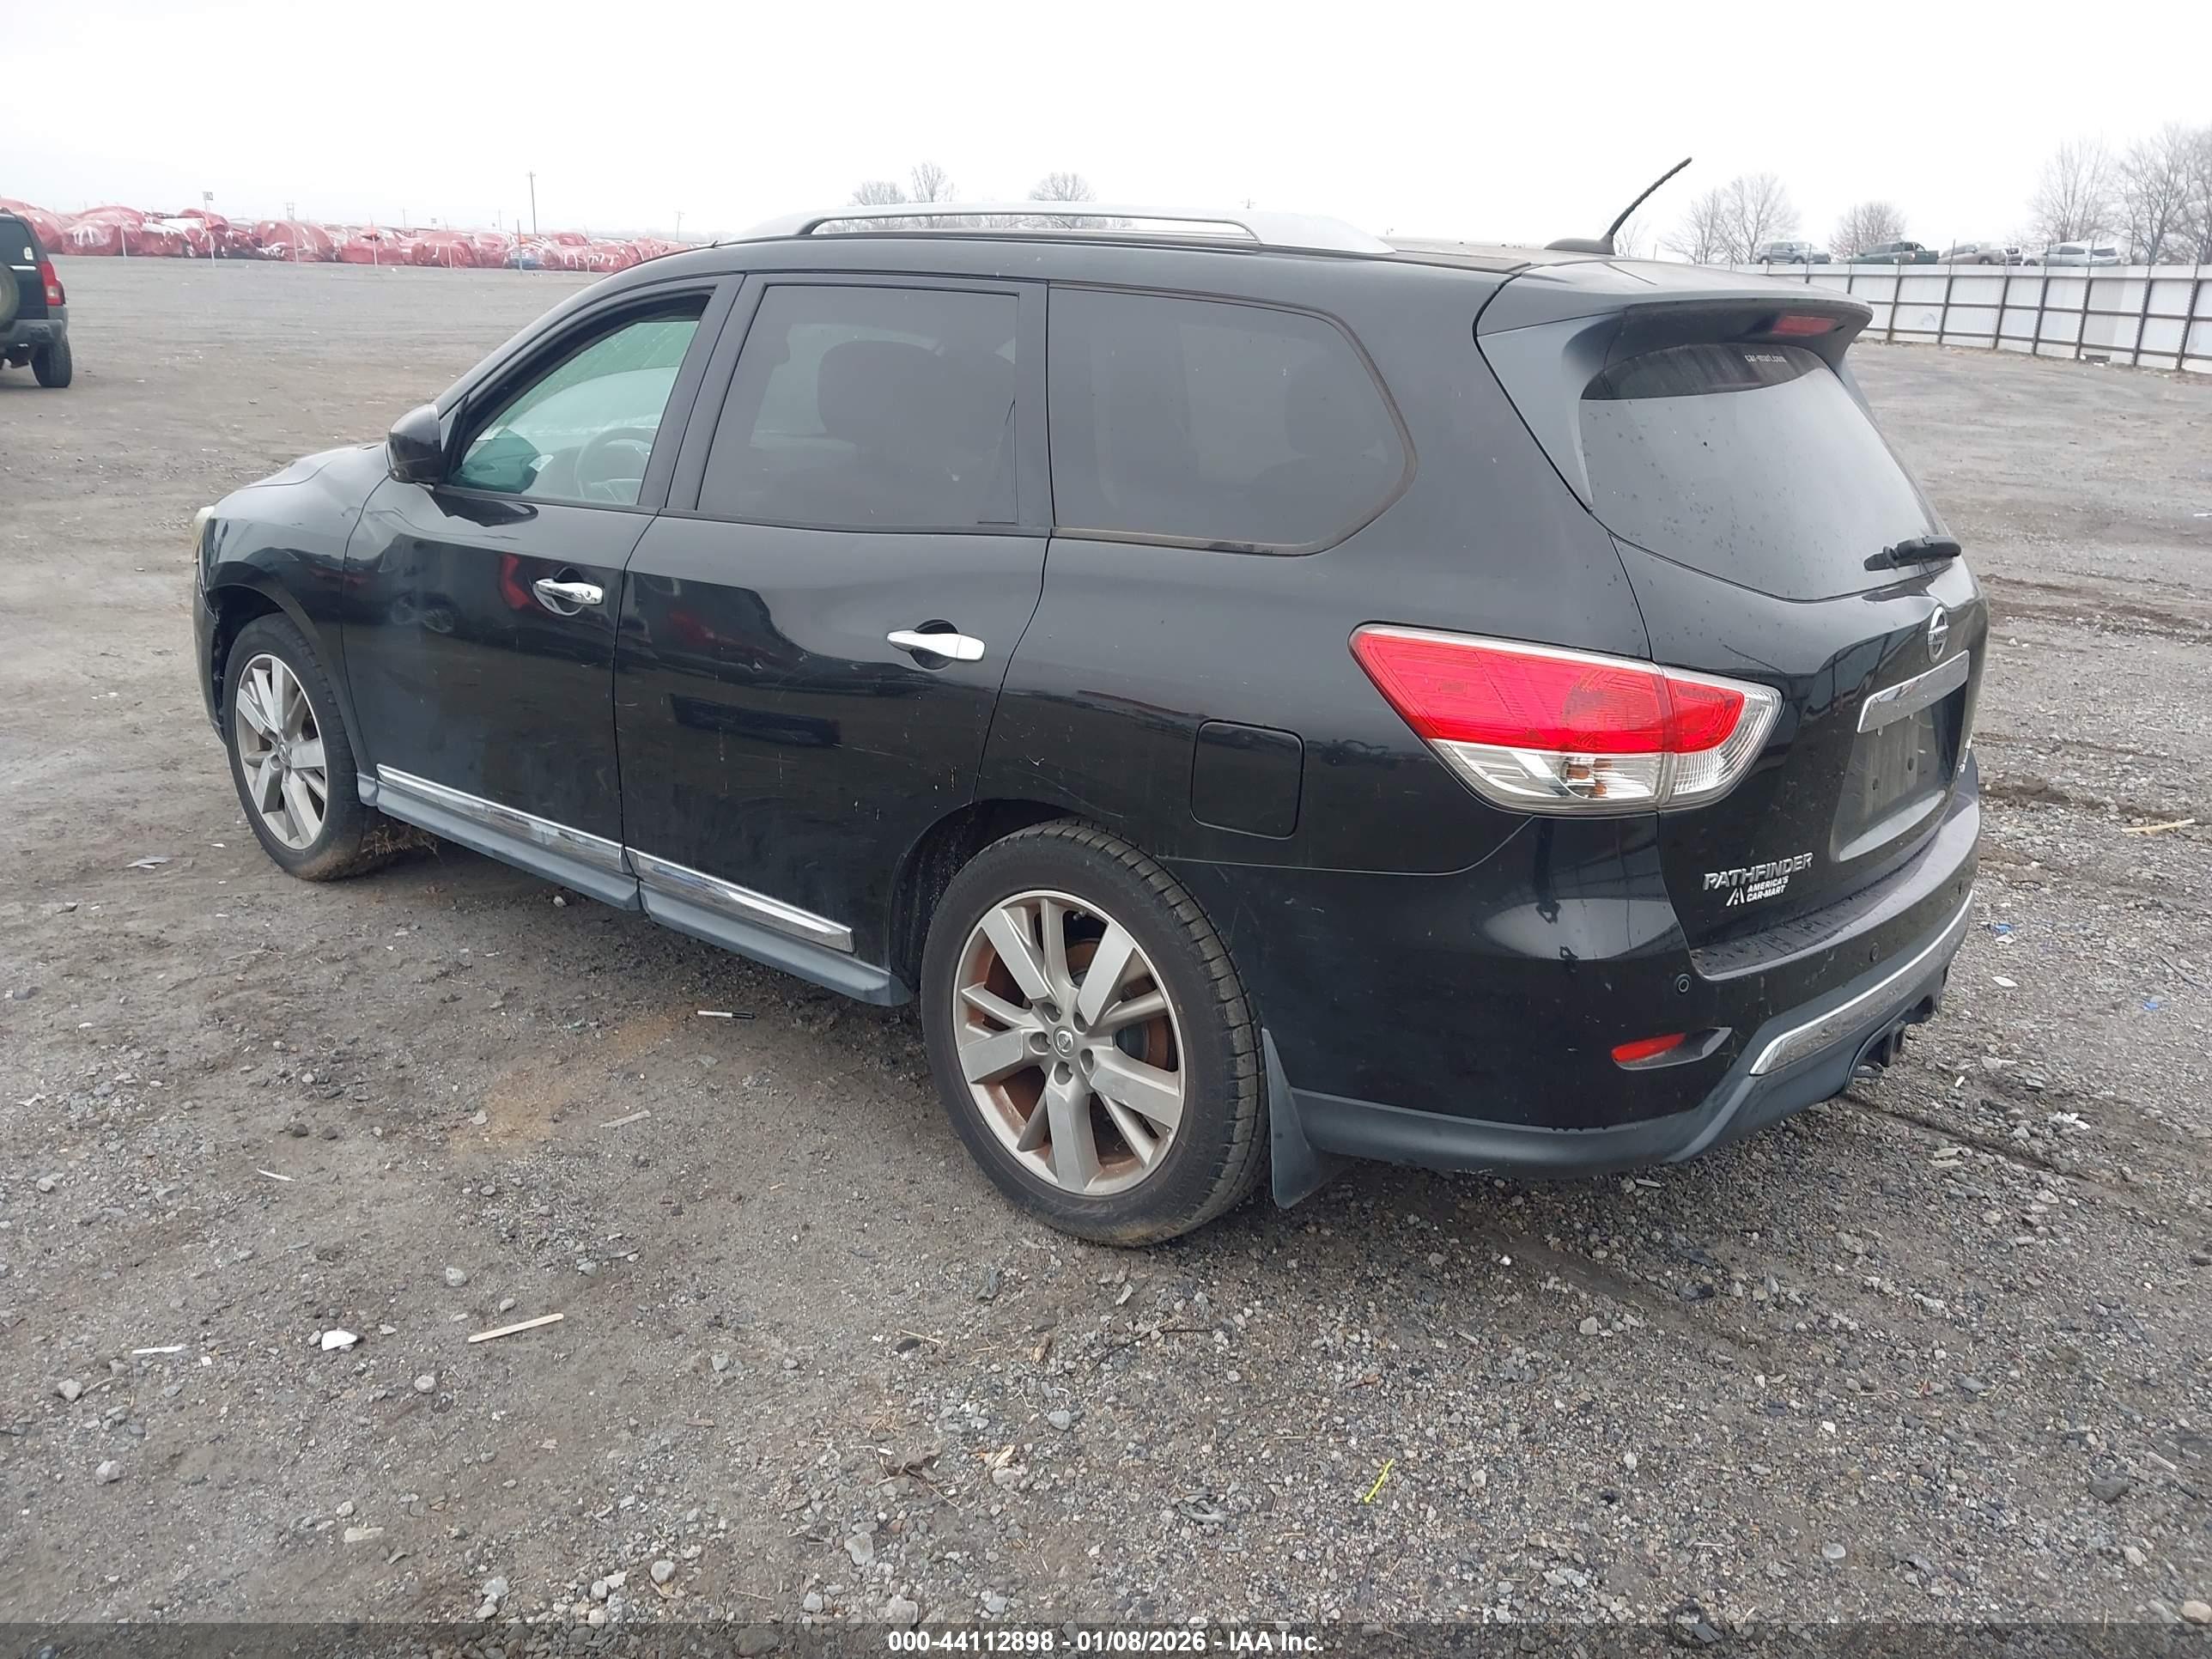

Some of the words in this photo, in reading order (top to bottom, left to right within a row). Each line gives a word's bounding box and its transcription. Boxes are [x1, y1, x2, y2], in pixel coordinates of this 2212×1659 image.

[1702, 852, 1814, 891] PATHFINDER
[1746, 884, 1786, 902] CAR-MART
[1747, 874, 1790, 894] AMERICA'S
